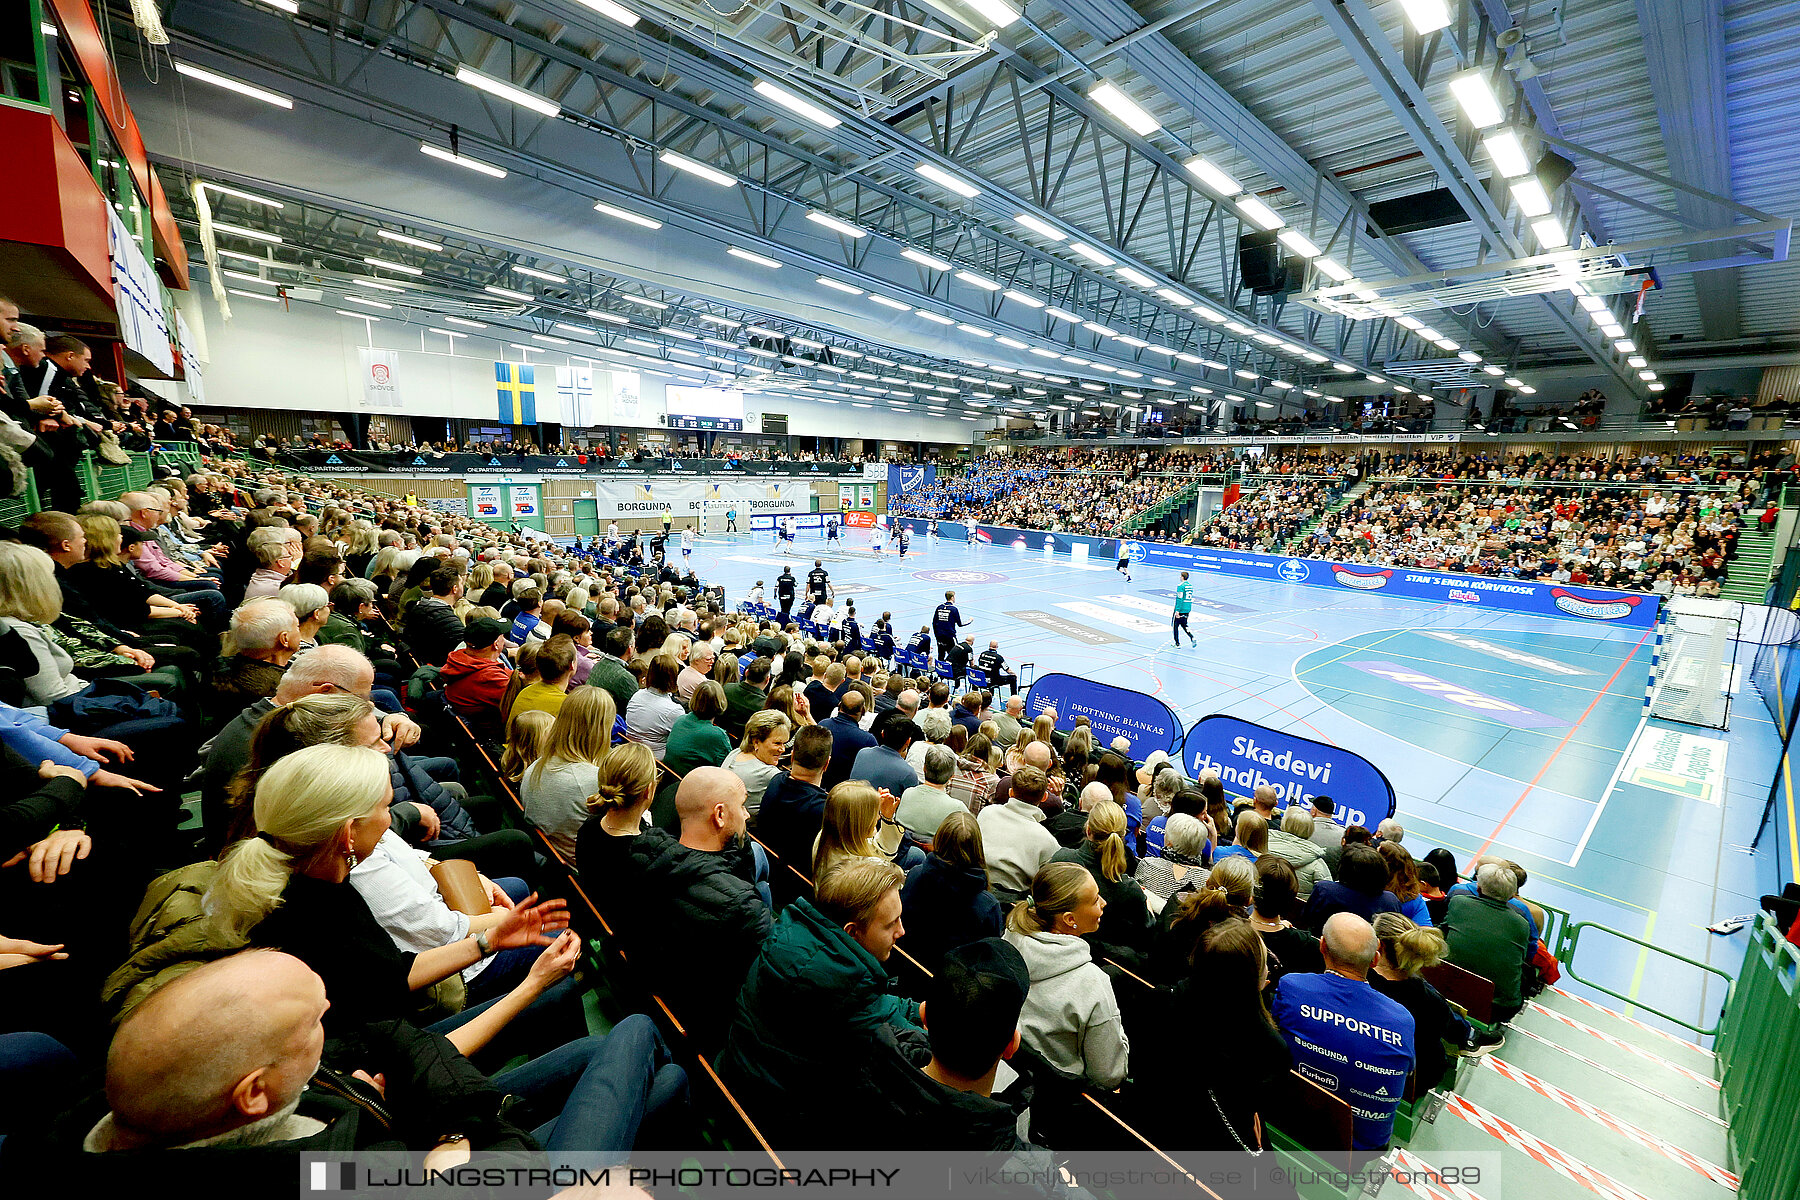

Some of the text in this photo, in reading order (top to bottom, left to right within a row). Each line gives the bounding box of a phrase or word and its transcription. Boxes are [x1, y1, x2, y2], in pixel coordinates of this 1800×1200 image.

[866, 464, 886, 478] SBB
[617, 502, 672, 511] BORGUNDA
[1441, 578, 1470, 588] ENDA
[1072, 703, 1165, 735] DROTTNING BLANKAS
[1231, 736, 1332, 784] Skadevi
[1678, 746, 1714, 780] Lagerhus
[1192, 752, 1366, 827] Handbollsup
[1300, 1004, 1402, 1047] SUPPORTER
[1302, 1040, 1348, 1062] BORGUNDA
[1302, 1067, 1335, 1086] Furhoffs
